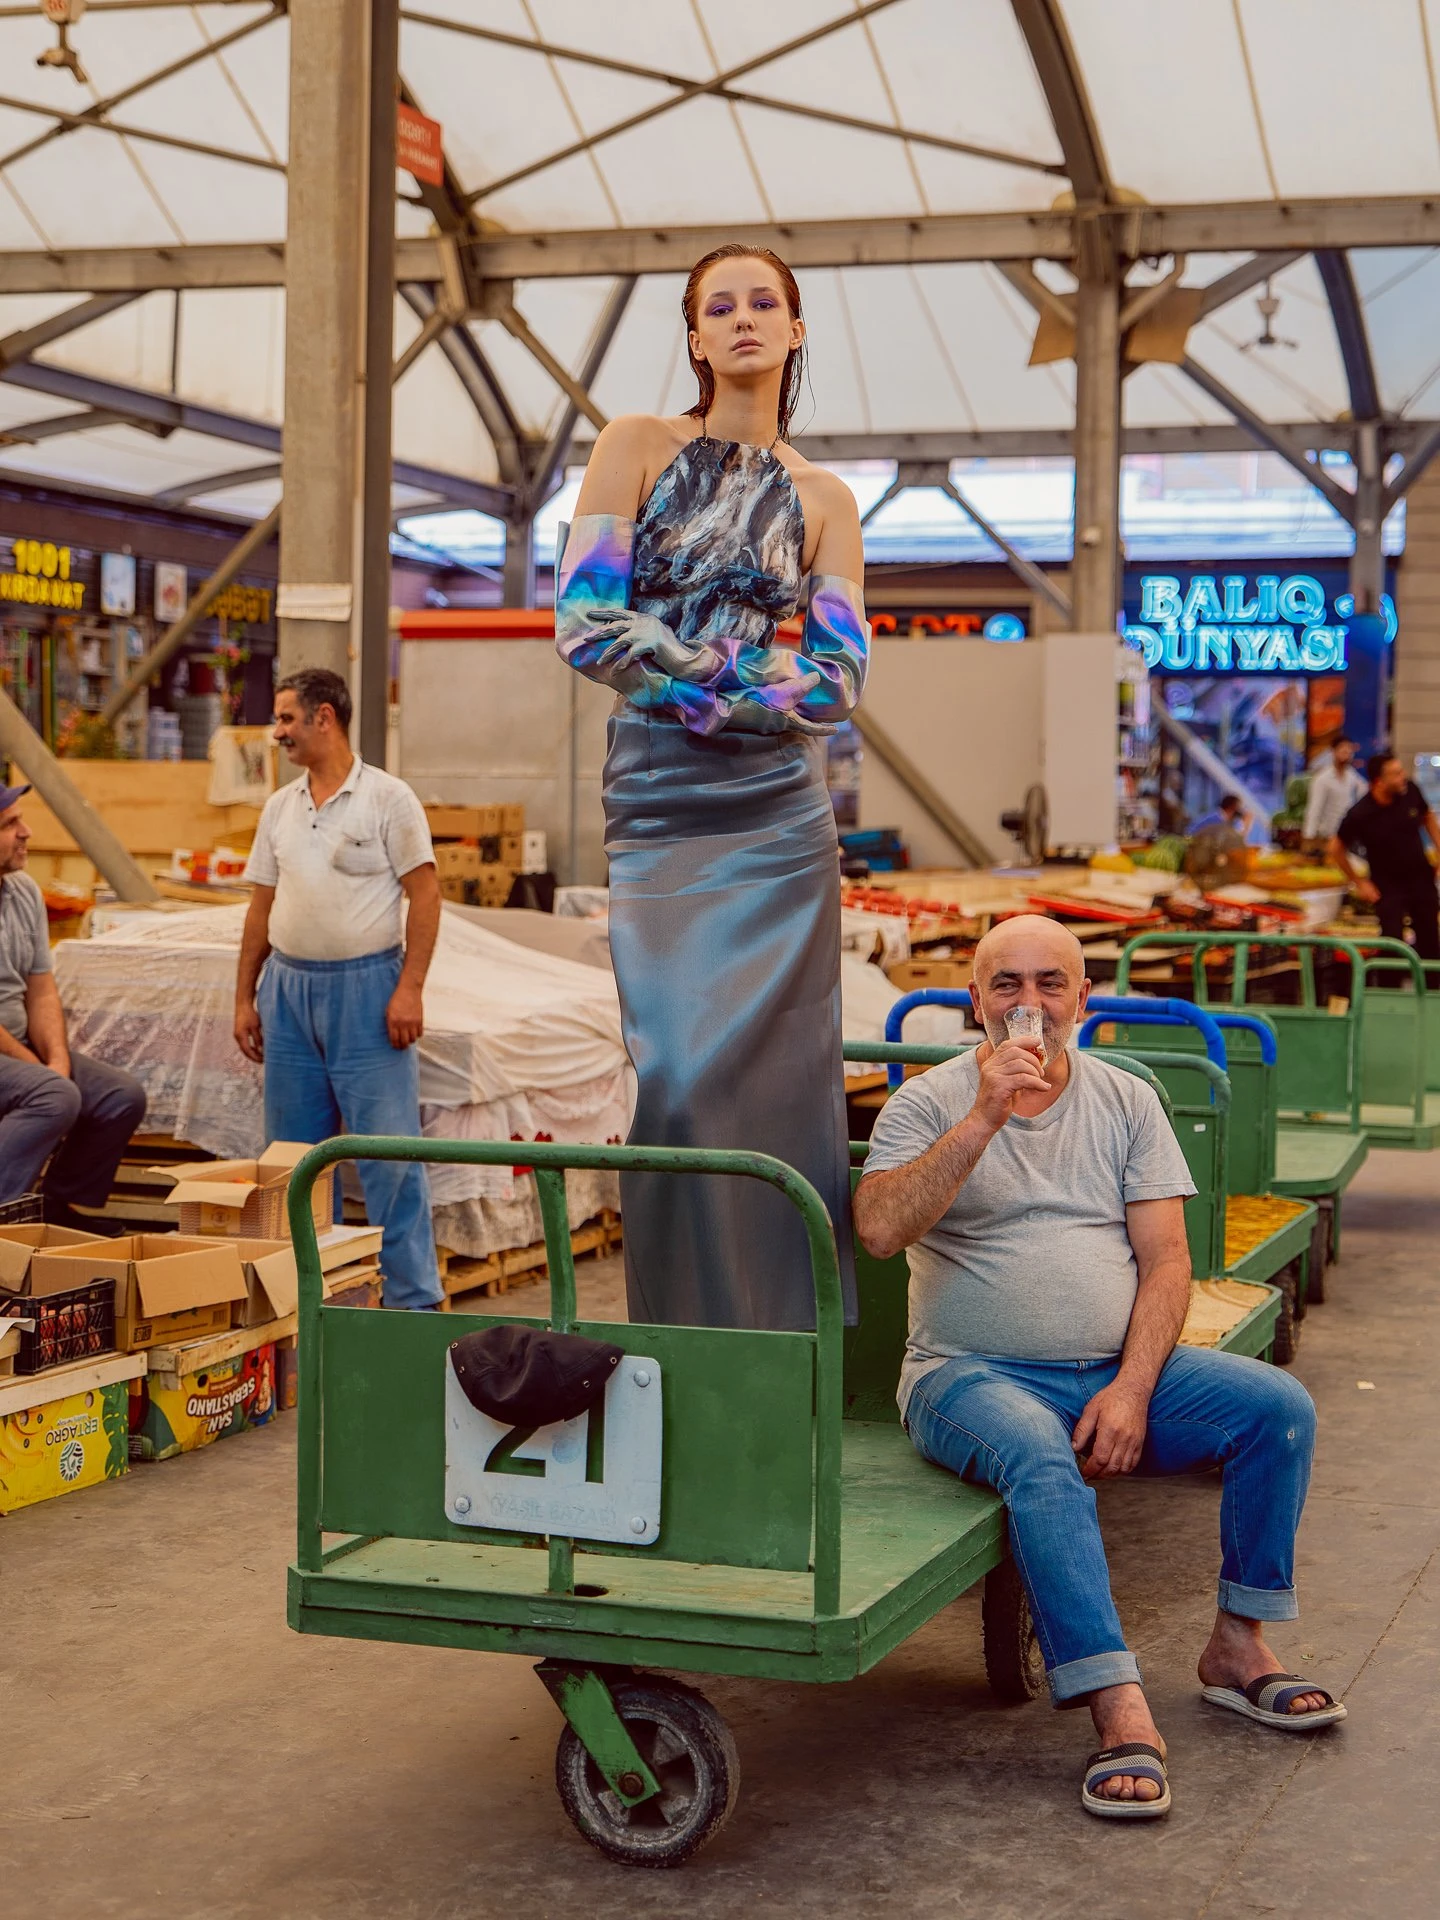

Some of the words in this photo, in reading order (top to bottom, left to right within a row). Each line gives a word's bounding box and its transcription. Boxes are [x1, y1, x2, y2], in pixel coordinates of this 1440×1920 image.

[12, 538, 71, 580] 1001
[1139, 574, 1328, 628] BALIQ
[187, 1376, 255, 1416] SEBASTIANO
[46, 1418, 98, 1446] ERTAGRO
[207, 1410, 233, 1434] SAN
